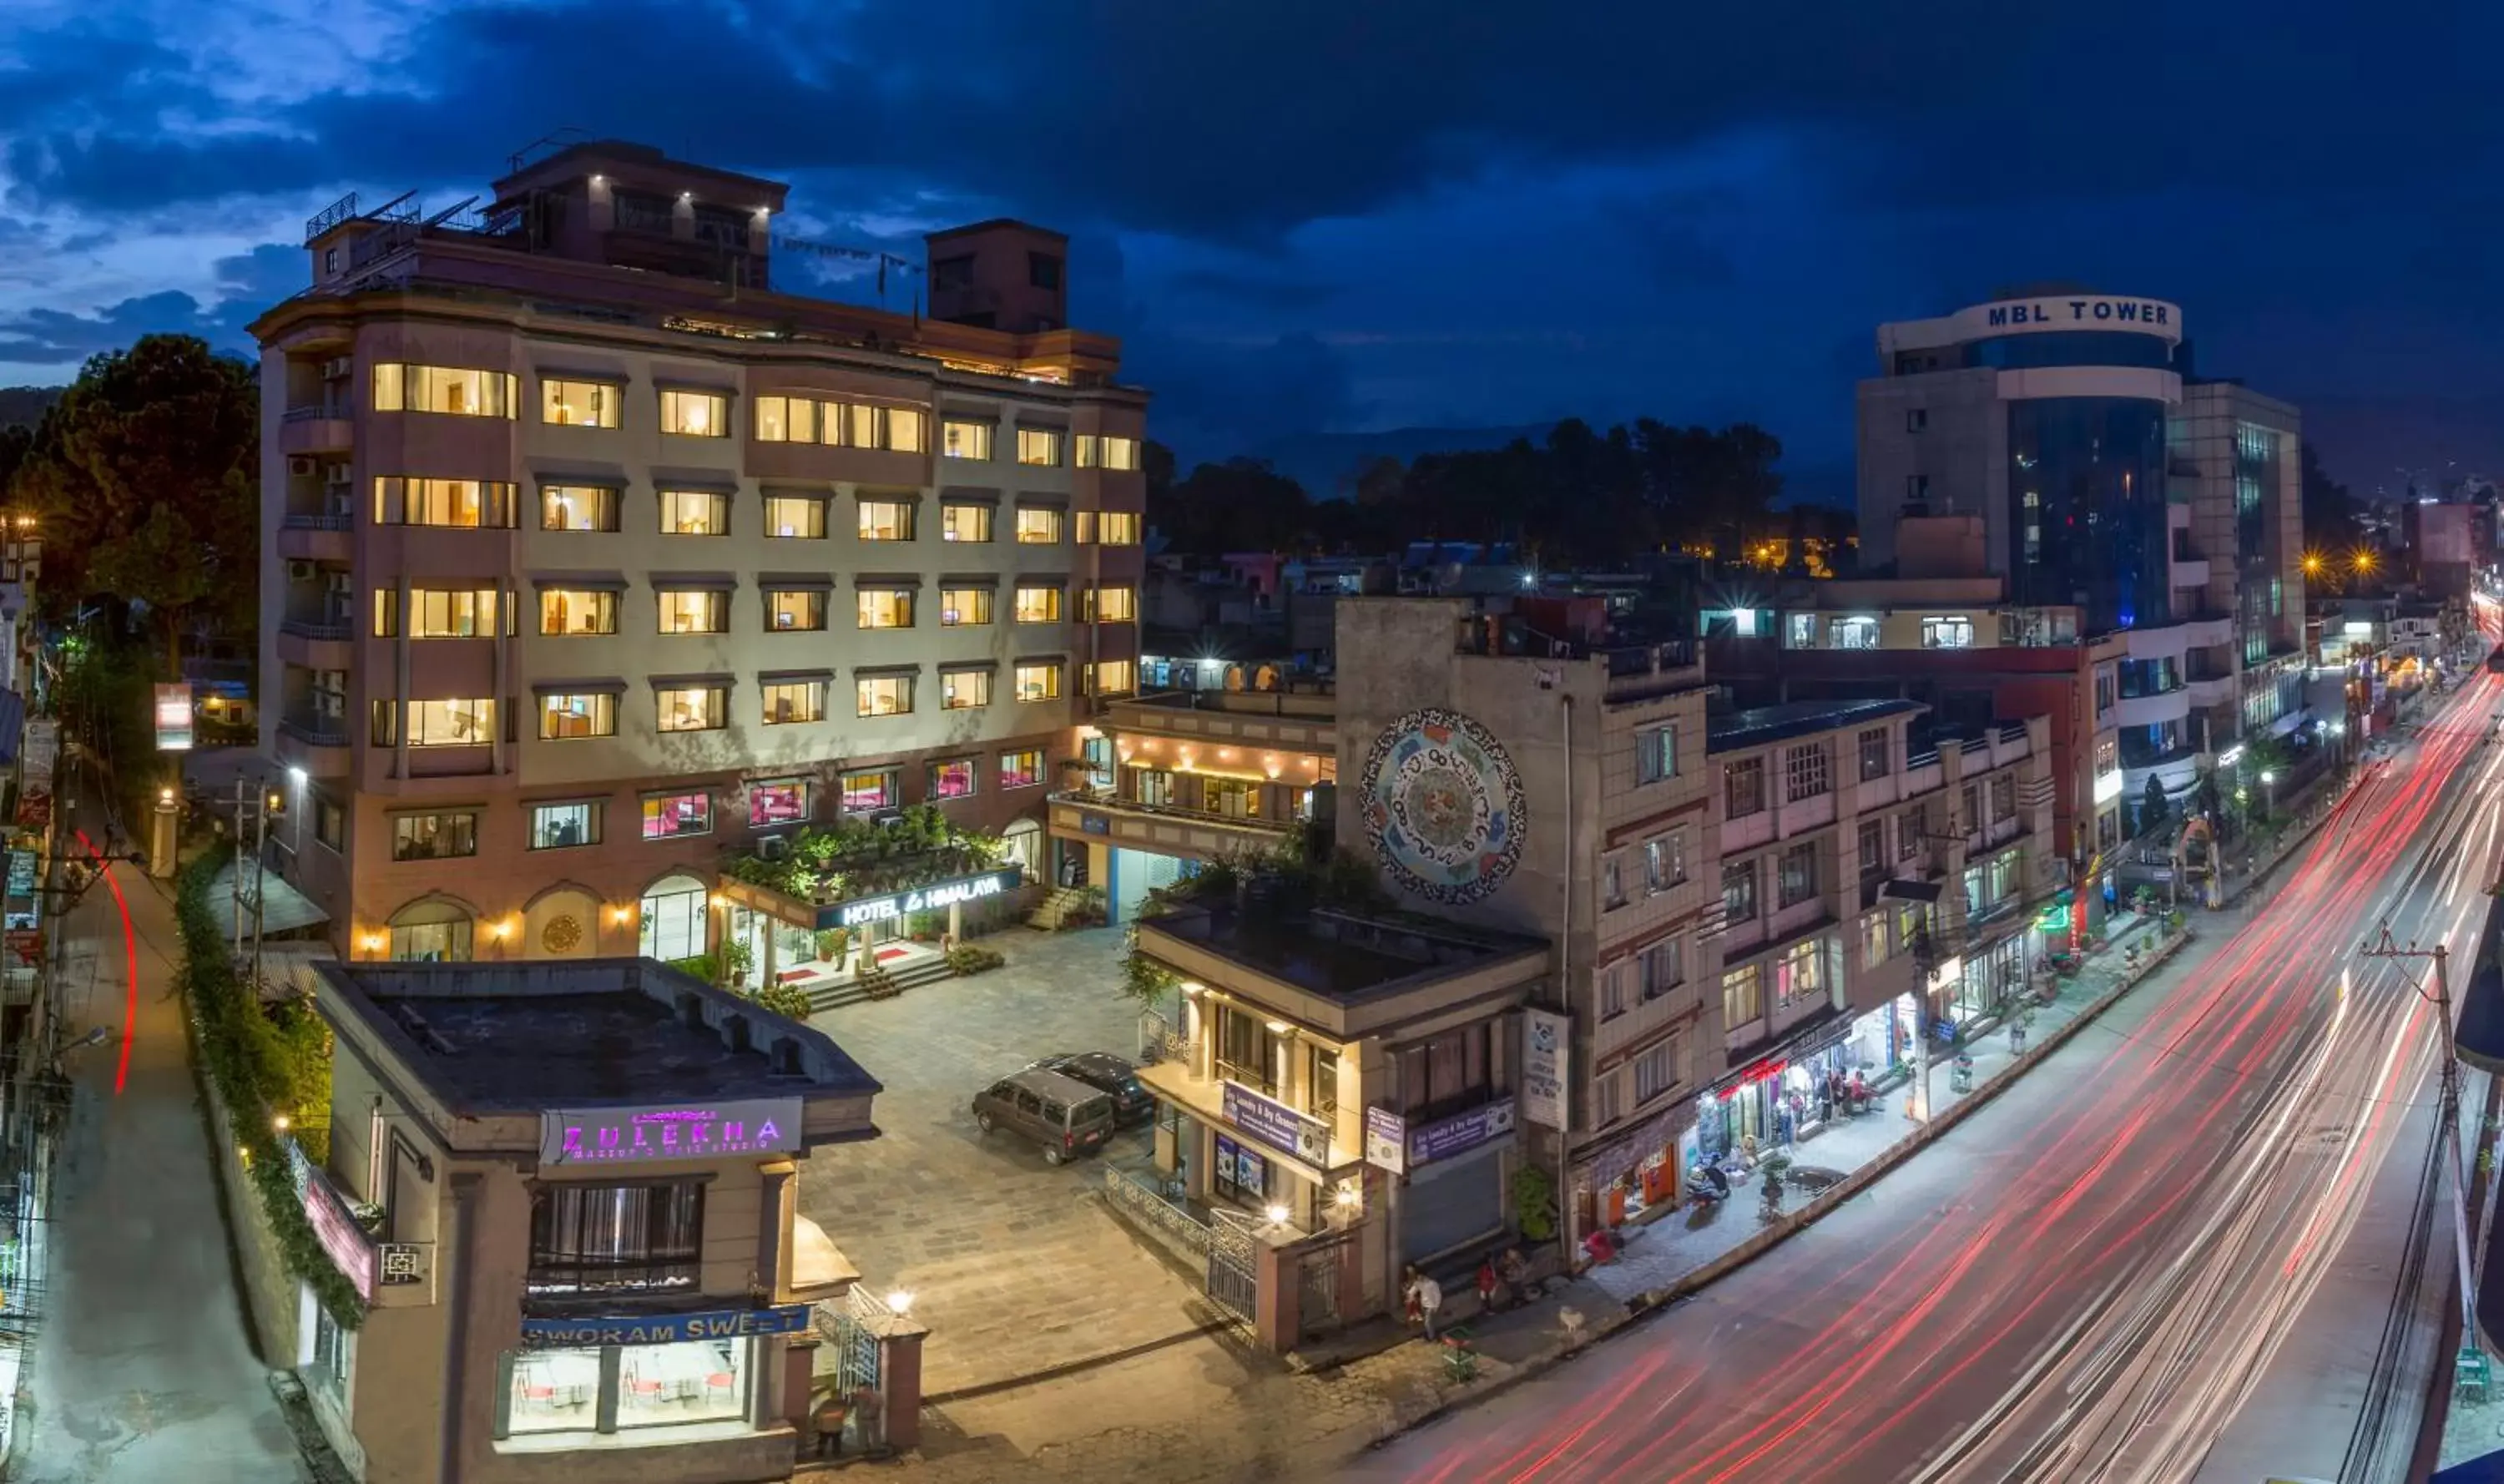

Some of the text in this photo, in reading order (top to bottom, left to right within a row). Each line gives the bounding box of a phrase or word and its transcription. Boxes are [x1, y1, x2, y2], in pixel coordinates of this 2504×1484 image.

[1989, 301, 2168, 327] MBL TOWER
[844, 876, 1000, 925] HOTEL HIMALAYA
[563, 1116, 780, 1152] ZULEKHA
